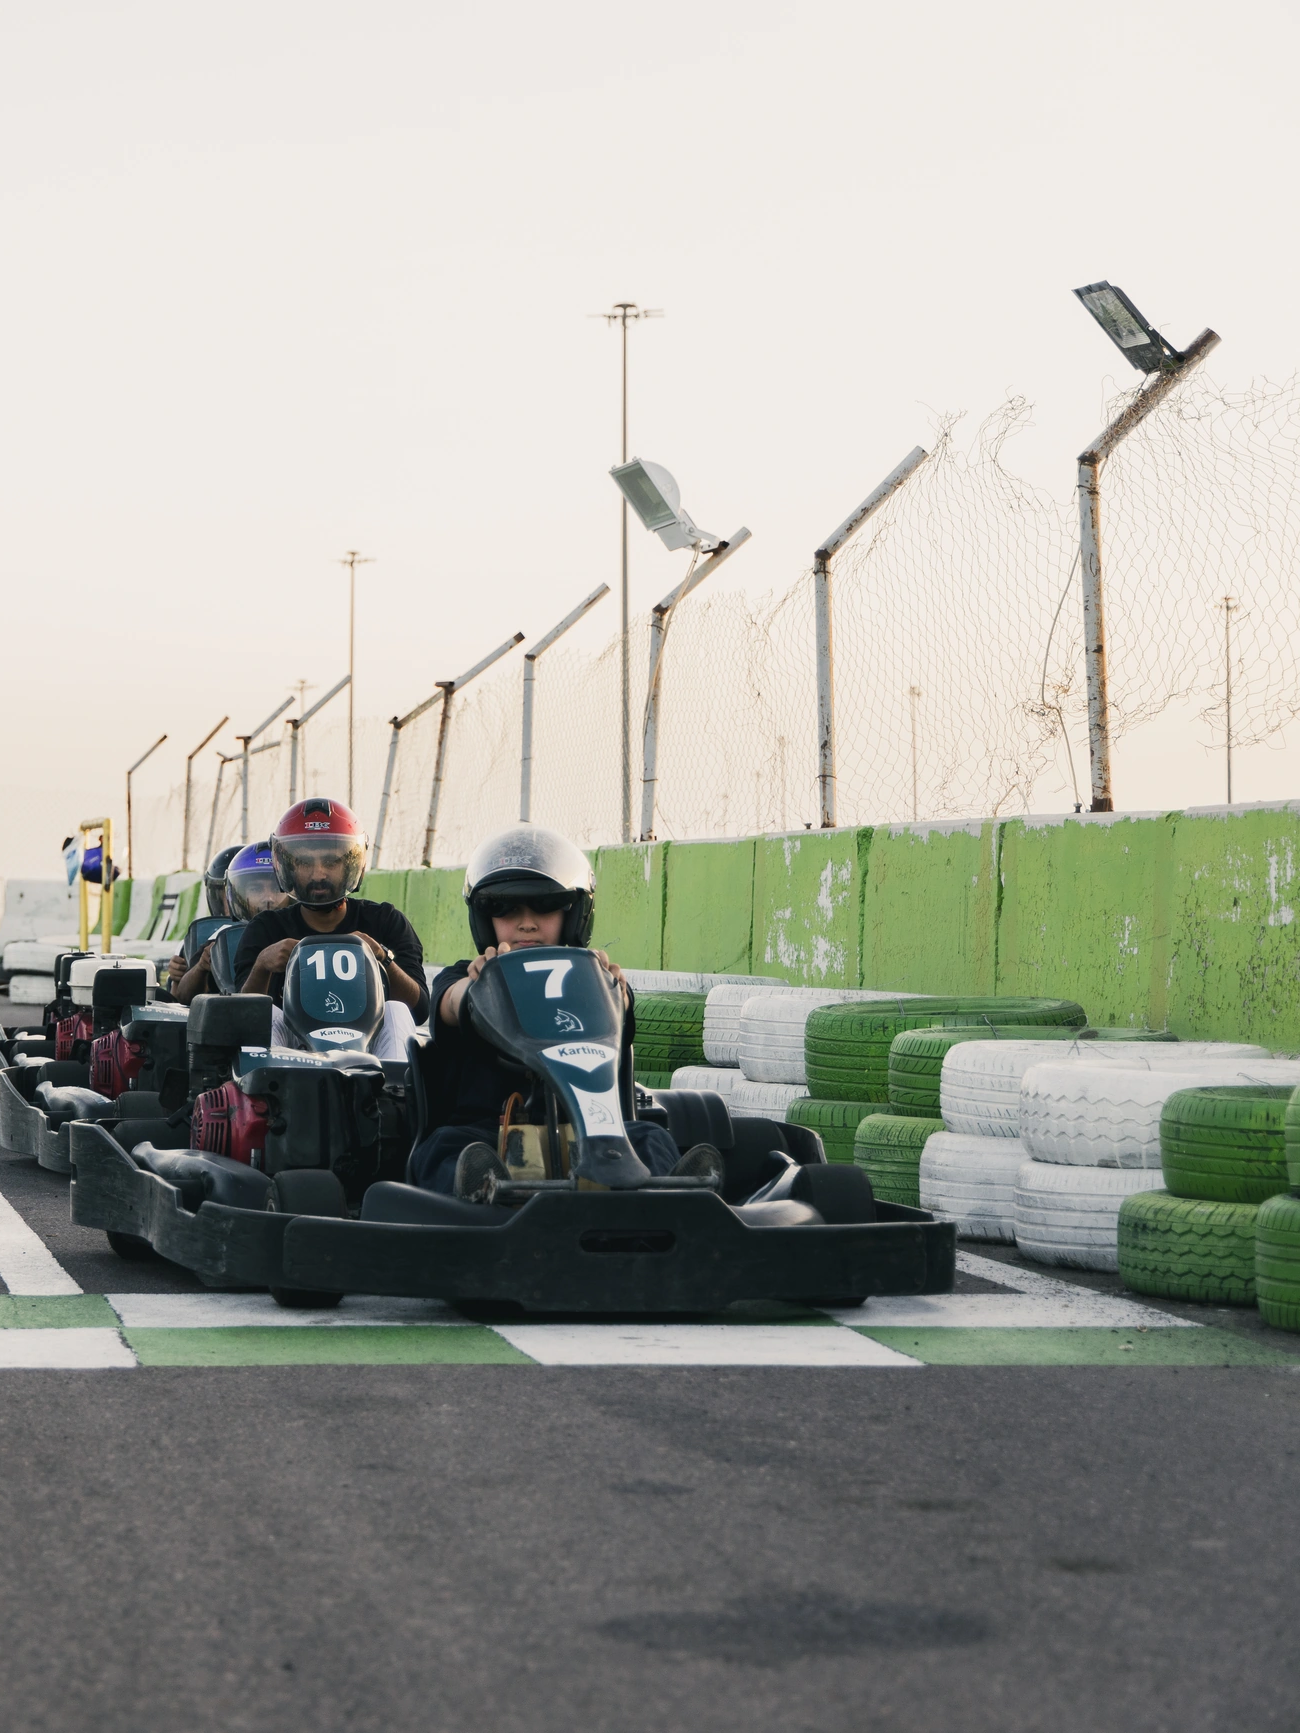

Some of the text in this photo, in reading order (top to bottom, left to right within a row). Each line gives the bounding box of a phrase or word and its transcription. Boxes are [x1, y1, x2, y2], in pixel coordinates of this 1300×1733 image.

[307, 950, 358, 980] 10
[523, 959, 573, 998] 7
[320, 1029, 355, 1038] Karting
[557, 1046, 607, 1058] Karting
[271, 1053, 323, 1067] Karting
